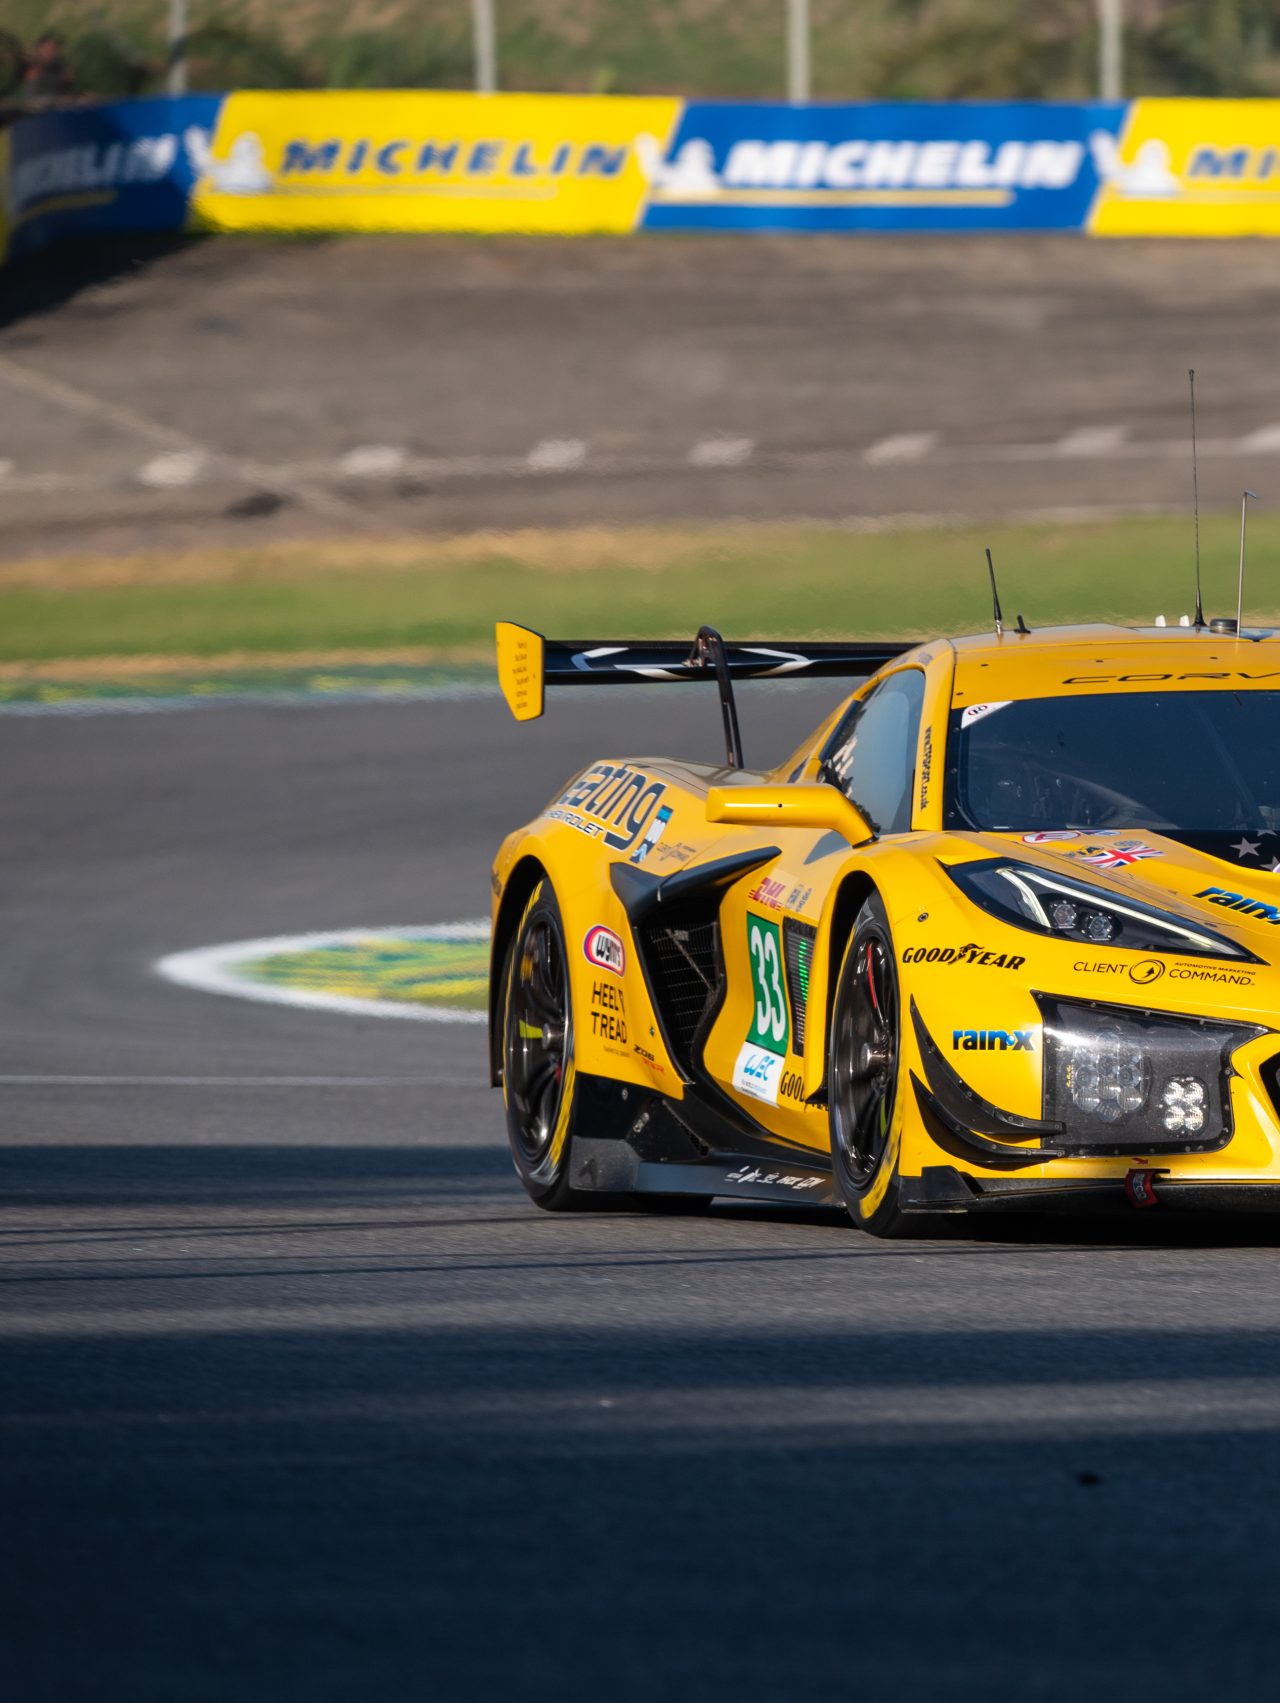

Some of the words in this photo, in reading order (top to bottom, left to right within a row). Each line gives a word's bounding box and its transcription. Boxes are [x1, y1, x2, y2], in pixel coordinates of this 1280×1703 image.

[281, 139, 628, 177] MICHELIN
[722, 139, 1086, 189] MICHELIN
[902, 943, 1026, 970] GOODYEAR
[1174, 962, 1217, 971] AUTOMOTIVE
[1218, 967, 1256, 975] MARKETING
[751, 925, 786, 1042] 33
[1073, 961, 1128, 974] CLIENT
[1169, 969, 1252, 986] COMMAND
[591, 1012, 627, 1044] TREAD
[743, 1054, 776, 1081] WEC
